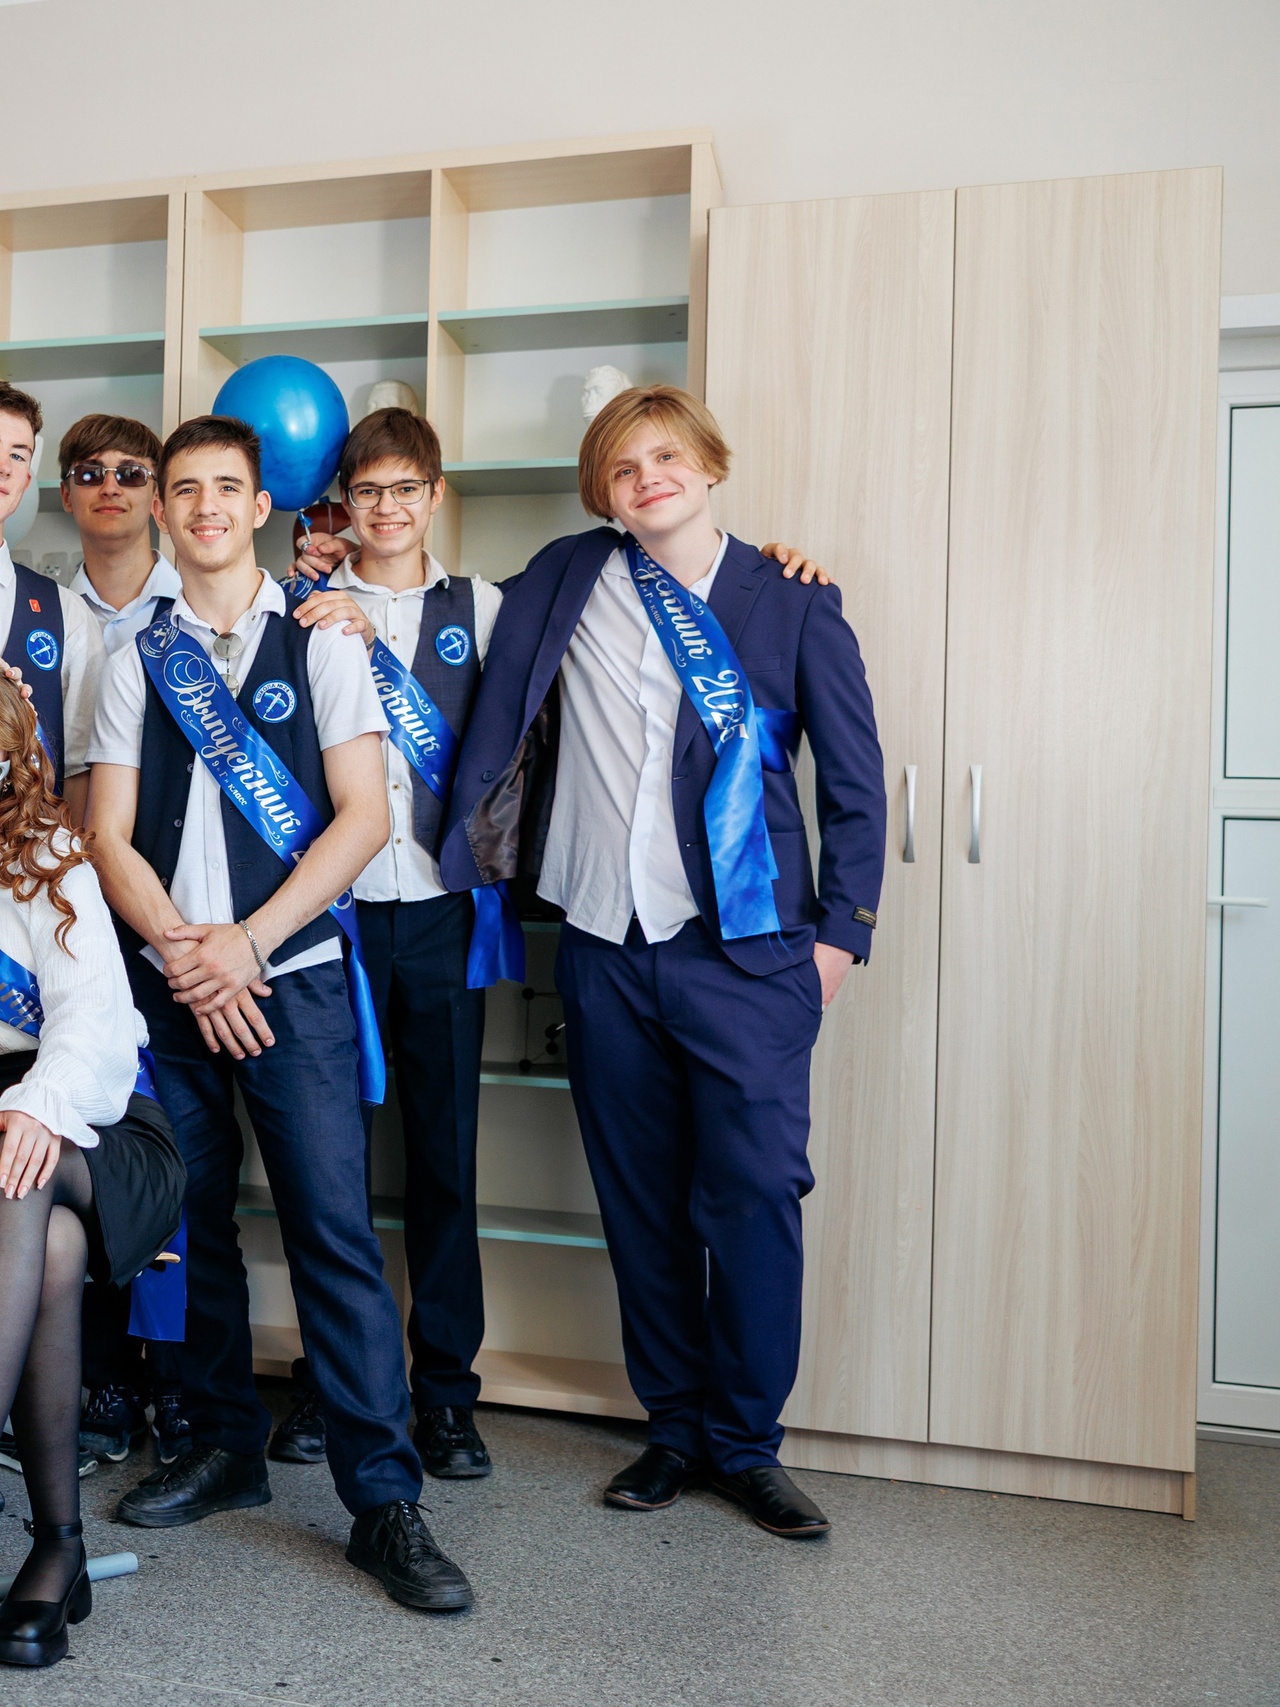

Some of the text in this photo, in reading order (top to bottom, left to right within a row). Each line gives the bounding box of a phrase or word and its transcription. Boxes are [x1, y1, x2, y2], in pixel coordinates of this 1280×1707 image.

[650, 604, 664, 627] класс
[162, 650, 301, 834] Выпускник
[227, 783, 248, 806] класс
